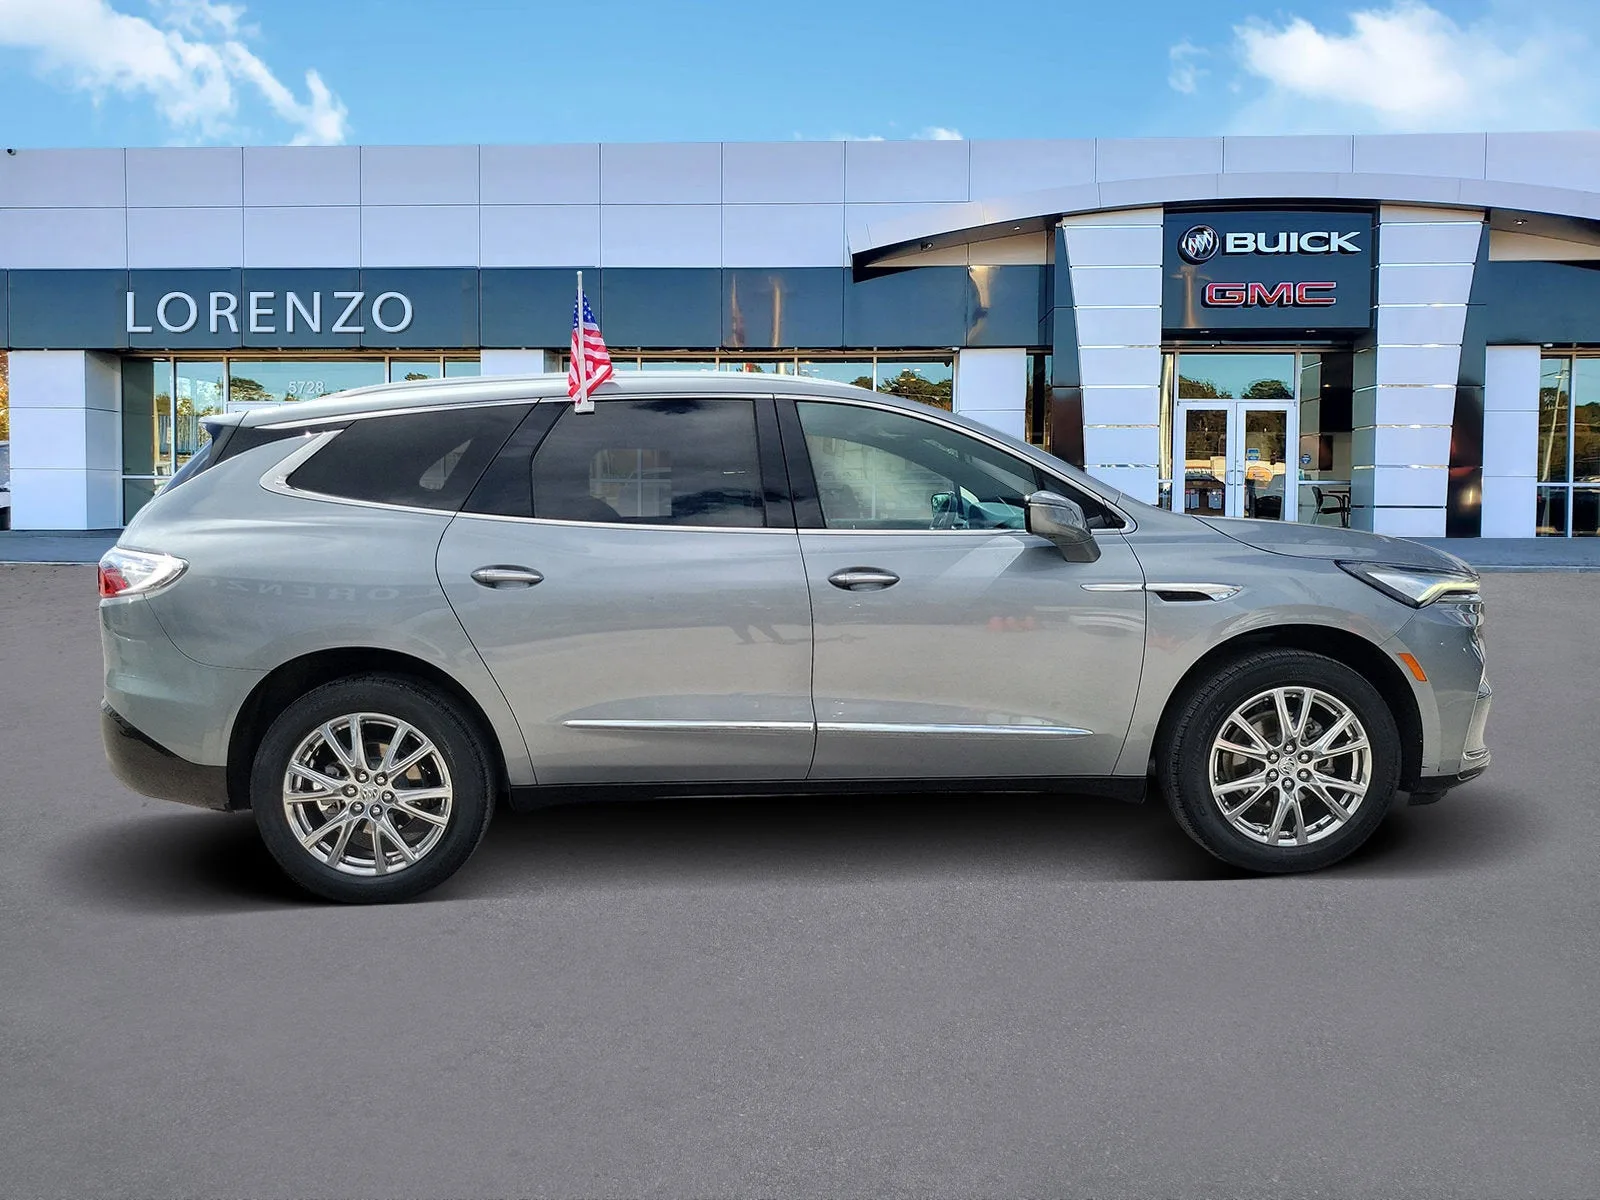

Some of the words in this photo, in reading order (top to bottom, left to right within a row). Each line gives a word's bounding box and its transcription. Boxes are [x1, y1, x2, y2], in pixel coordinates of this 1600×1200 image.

[1226, 231, 1362, 253] BUICK
[1207, 281, 1337, 305] GMC
[125, 291, 413, 333] LORENZO
[288, 380, 325, 394] 5728
